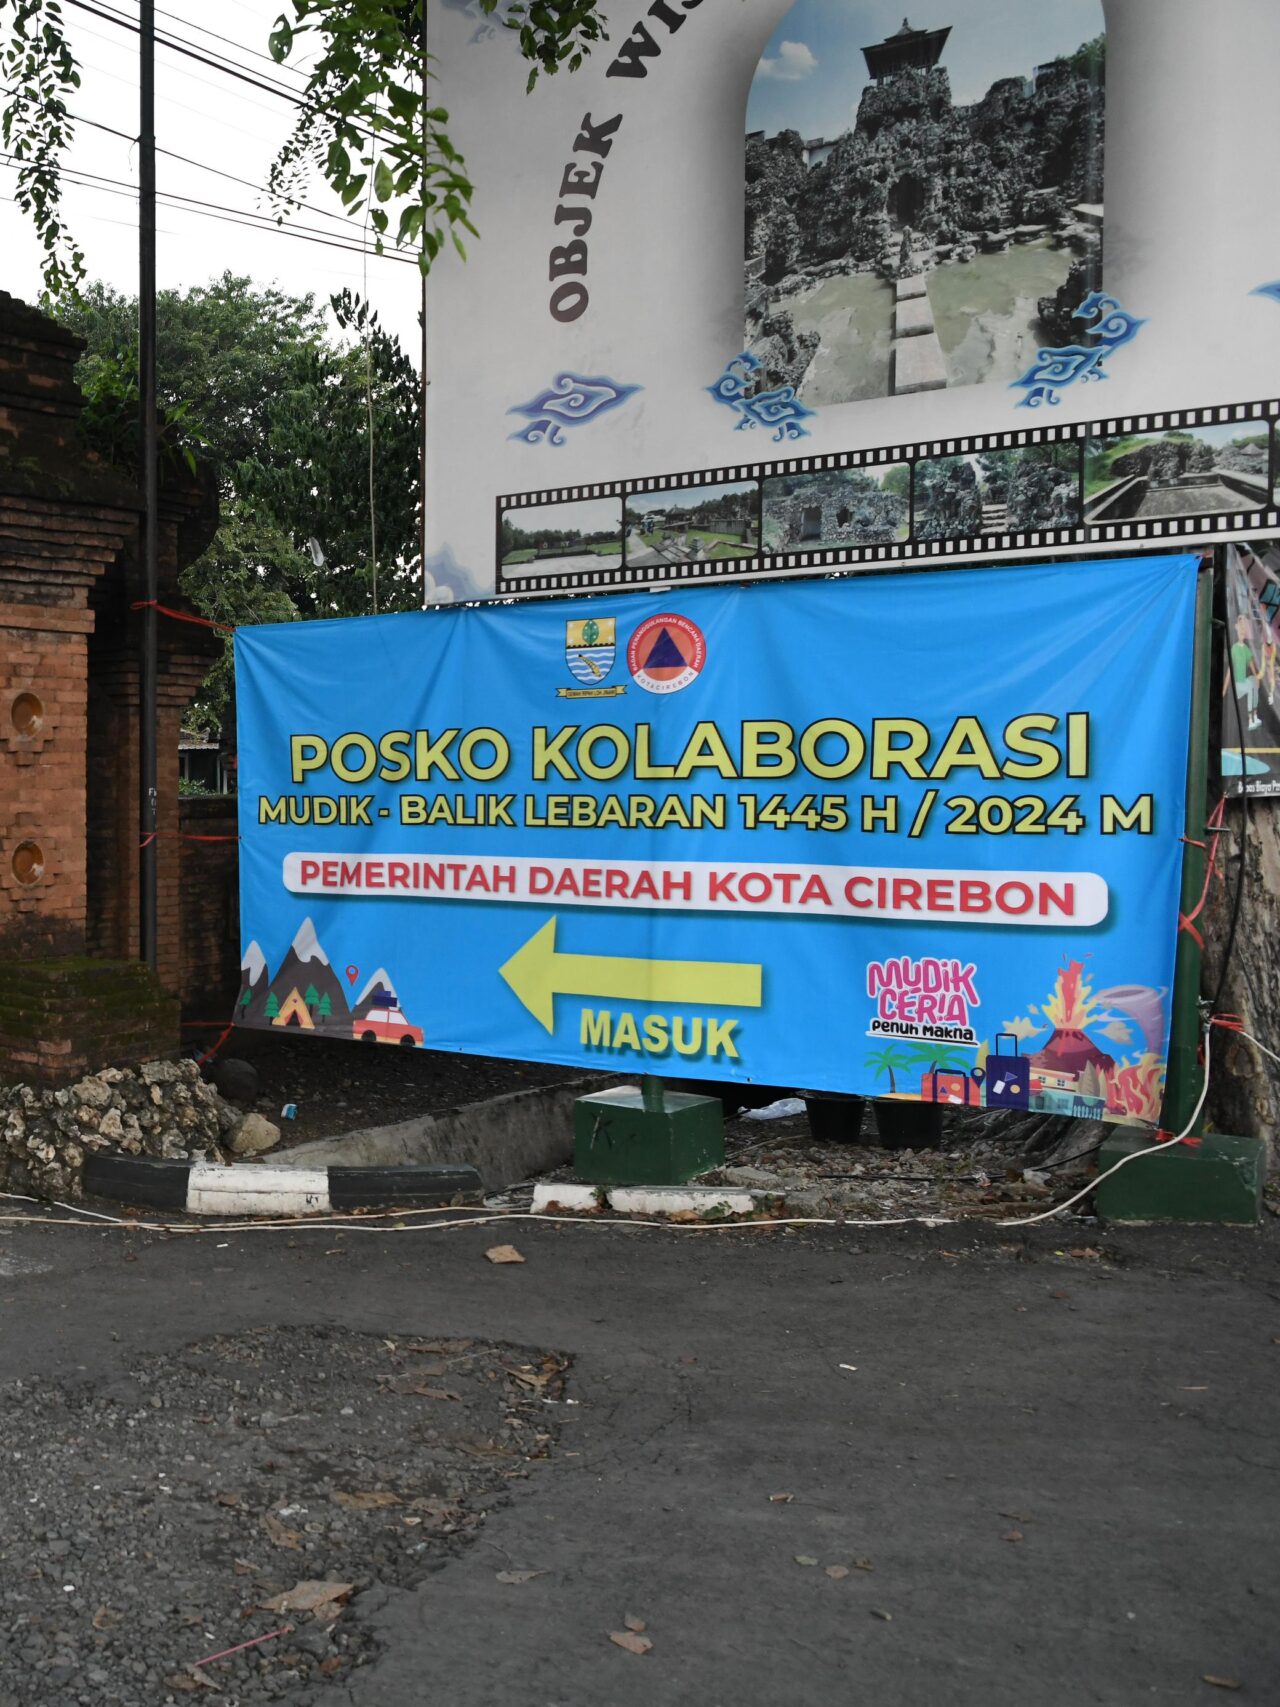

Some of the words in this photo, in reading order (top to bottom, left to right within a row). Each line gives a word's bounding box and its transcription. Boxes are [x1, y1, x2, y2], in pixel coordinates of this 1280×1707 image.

[548, 112, 623, 323] OBJEK
[290, 727, 511, 784] POSKO
[532, 712, 1089, 781] KOLABORASI
[258, 796, 374, 826] MUDIK
[400, 794, 517, 827] BALIK
[524, 794, 726, 829] LEBARAN
[738, 794, 848, 832] 1445
[861, 795, 898, 833] H
[907, 789, 940, 838] /
[945, 795, 1086, 836] 2024
[1099, 794, 1154, 835] M
[300, 860, 517, 893] PEMERINTAH
[528, 866, 692, 901] DAERAH
[708, 871, 832, 906] KOTA
[844, 877, 1074, 916] CIREBON
[580, 1008, 740, 1058] MASUK
